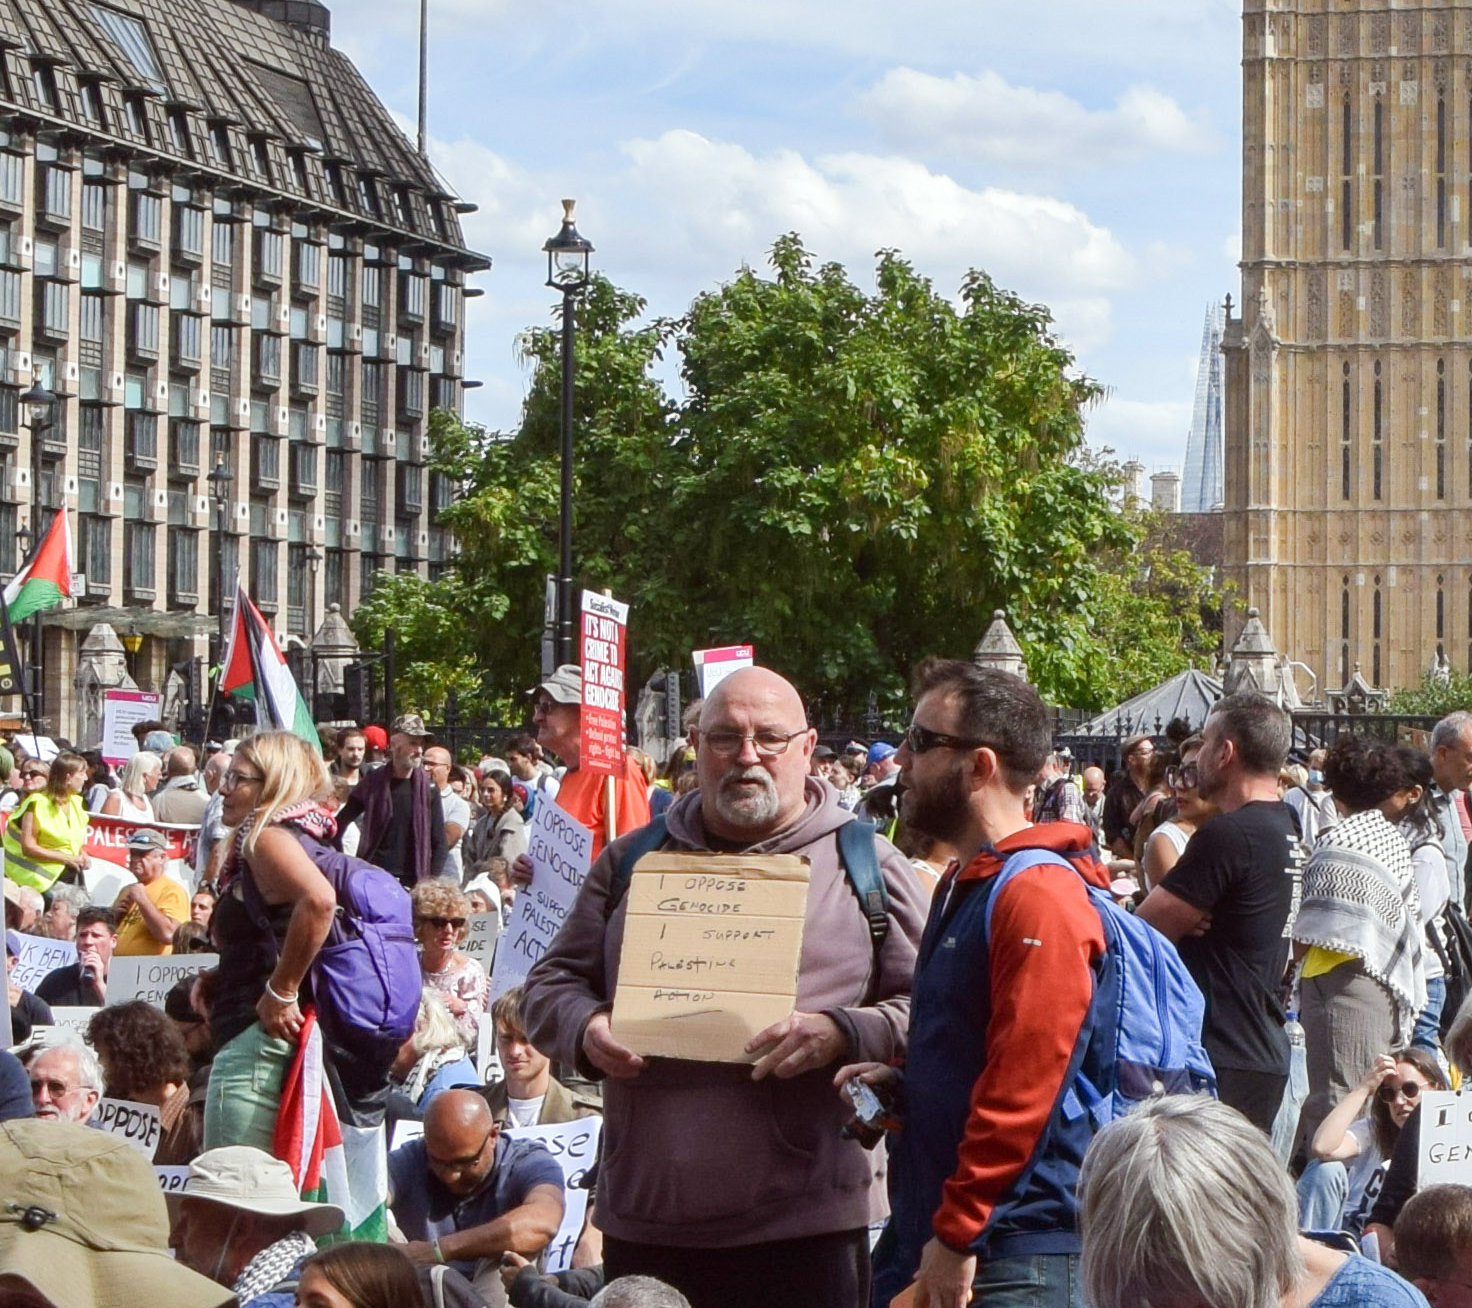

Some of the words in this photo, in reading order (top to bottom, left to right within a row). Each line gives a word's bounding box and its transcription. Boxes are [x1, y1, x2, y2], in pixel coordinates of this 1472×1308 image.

[585, 637, 609, 663] CRIME
[585, 660, 599, 684] ACT
[585, 683, 620, 712] GENOCIDE
[544, 808, 587, 859] OPPOSE
[659, 874, 666, 891] I
[684, 876, 747, 892] OPPOSE
[656, 897, 743, 915] GENOCIDE
[660, 923, 667, 940] I
[702, 927, 776, 942] SUPPORT
[98, 1103, 159, 1148] PPOSE
[1434, 1104, 1453, 1127] I
